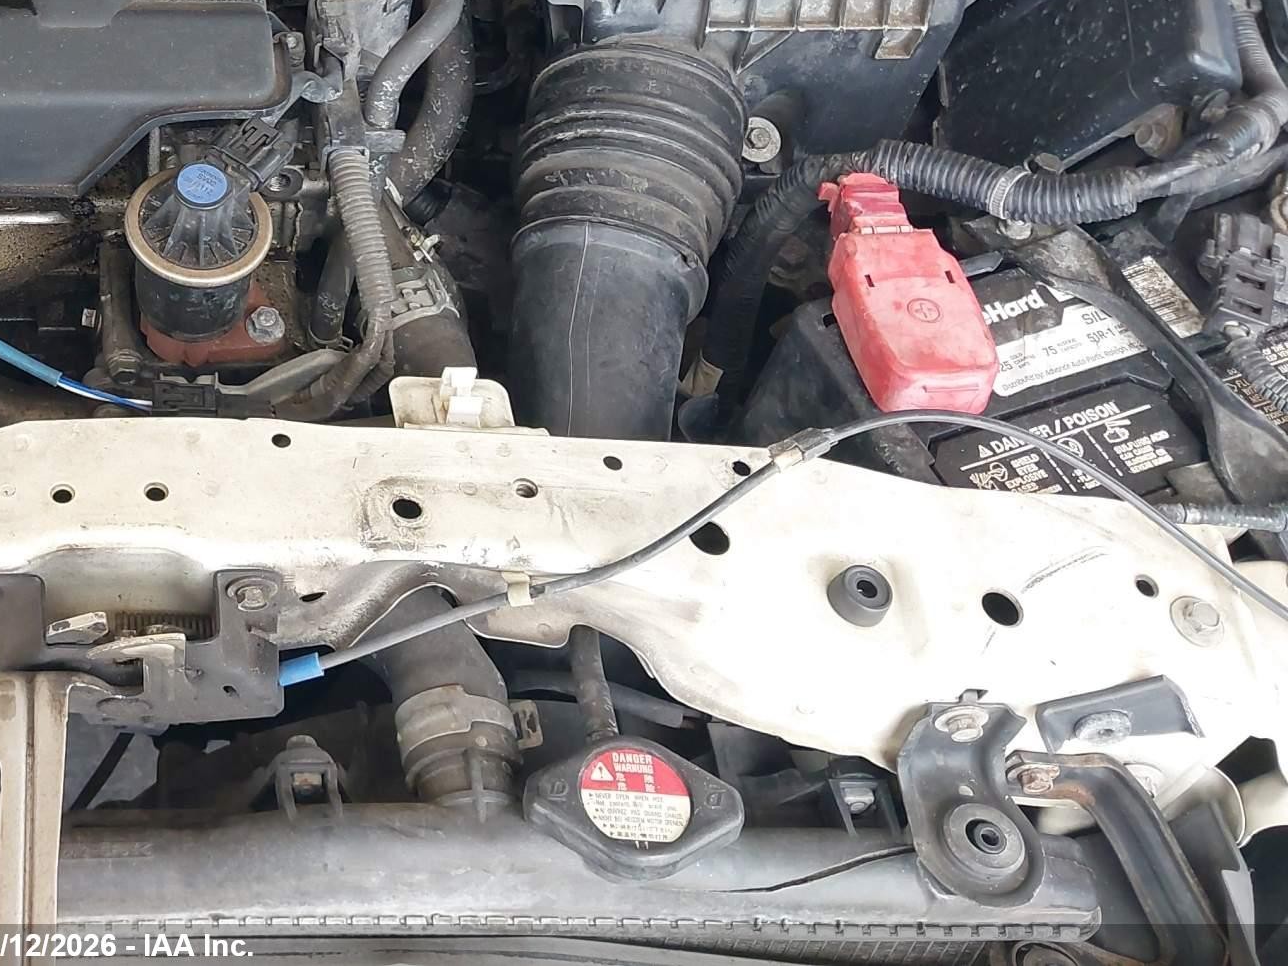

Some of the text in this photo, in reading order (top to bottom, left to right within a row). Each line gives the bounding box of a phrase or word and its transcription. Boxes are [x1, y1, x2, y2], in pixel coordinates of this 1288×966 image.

[983, 288, 1047, 324] eHard
[1082, 310, 1112, 325] SIL
[1042, 346, 1058, 356] 75
[989, 425, 1053, 454] DANER
[1063, 402, 1121, 429] POISON
[612, 753, 652, 763] DANGER
[614, 763, 654, 774] WARNUNG
